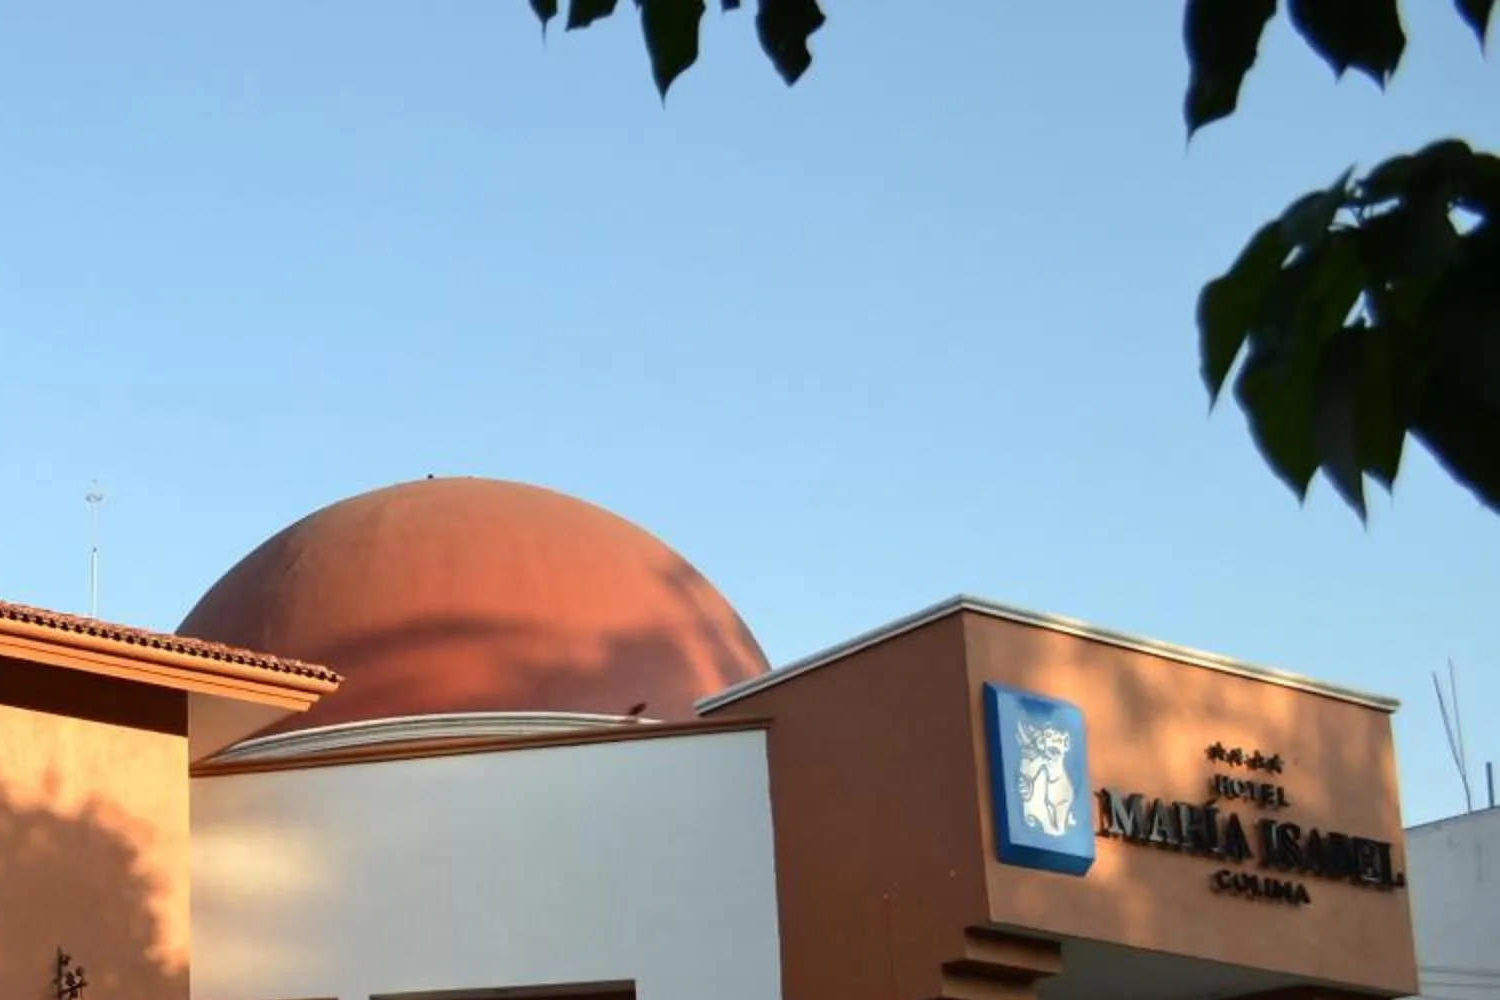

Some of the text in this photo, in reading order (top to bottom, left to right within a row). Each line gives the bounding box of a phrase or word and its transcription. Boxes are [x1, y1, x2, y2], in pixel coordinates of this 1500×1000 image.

[1209, 773, 1290, 808] HOTEL
[1255, 818, 1406, 891] ISABEL
[1210, 869, 1312, 905] COLIMA
